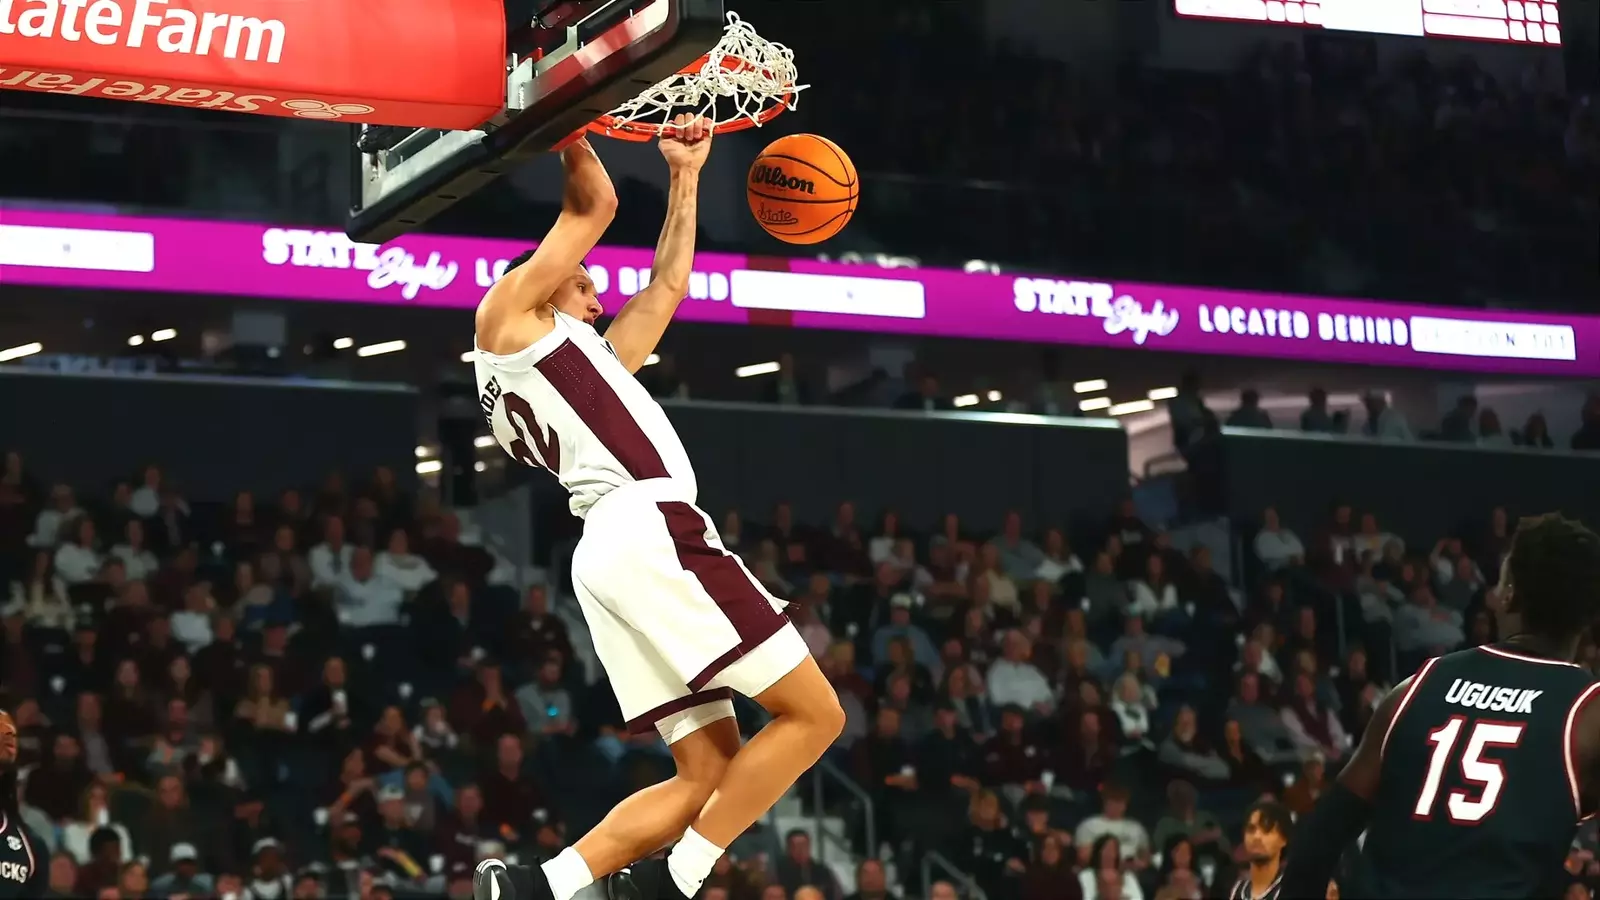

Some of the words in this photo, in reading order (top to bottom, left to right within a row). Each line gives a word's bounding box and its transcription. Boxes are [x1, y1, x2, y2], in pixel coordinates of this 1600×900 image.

[0, 0, 122, 45] tate
[0, 69, 106, 95] Far
[753, 164, 816, 195] Wilson
[1013, 277, 1113, 317] STATE
[1199, 304, 1310, 339] LOCATED
[1318, 312, 1409, 346] BEHIND
[1446, 678, 1543, 713] UGUSUK
[1412, 714, 1527, 826] 15
[0, 861, 28, 883] CKS
